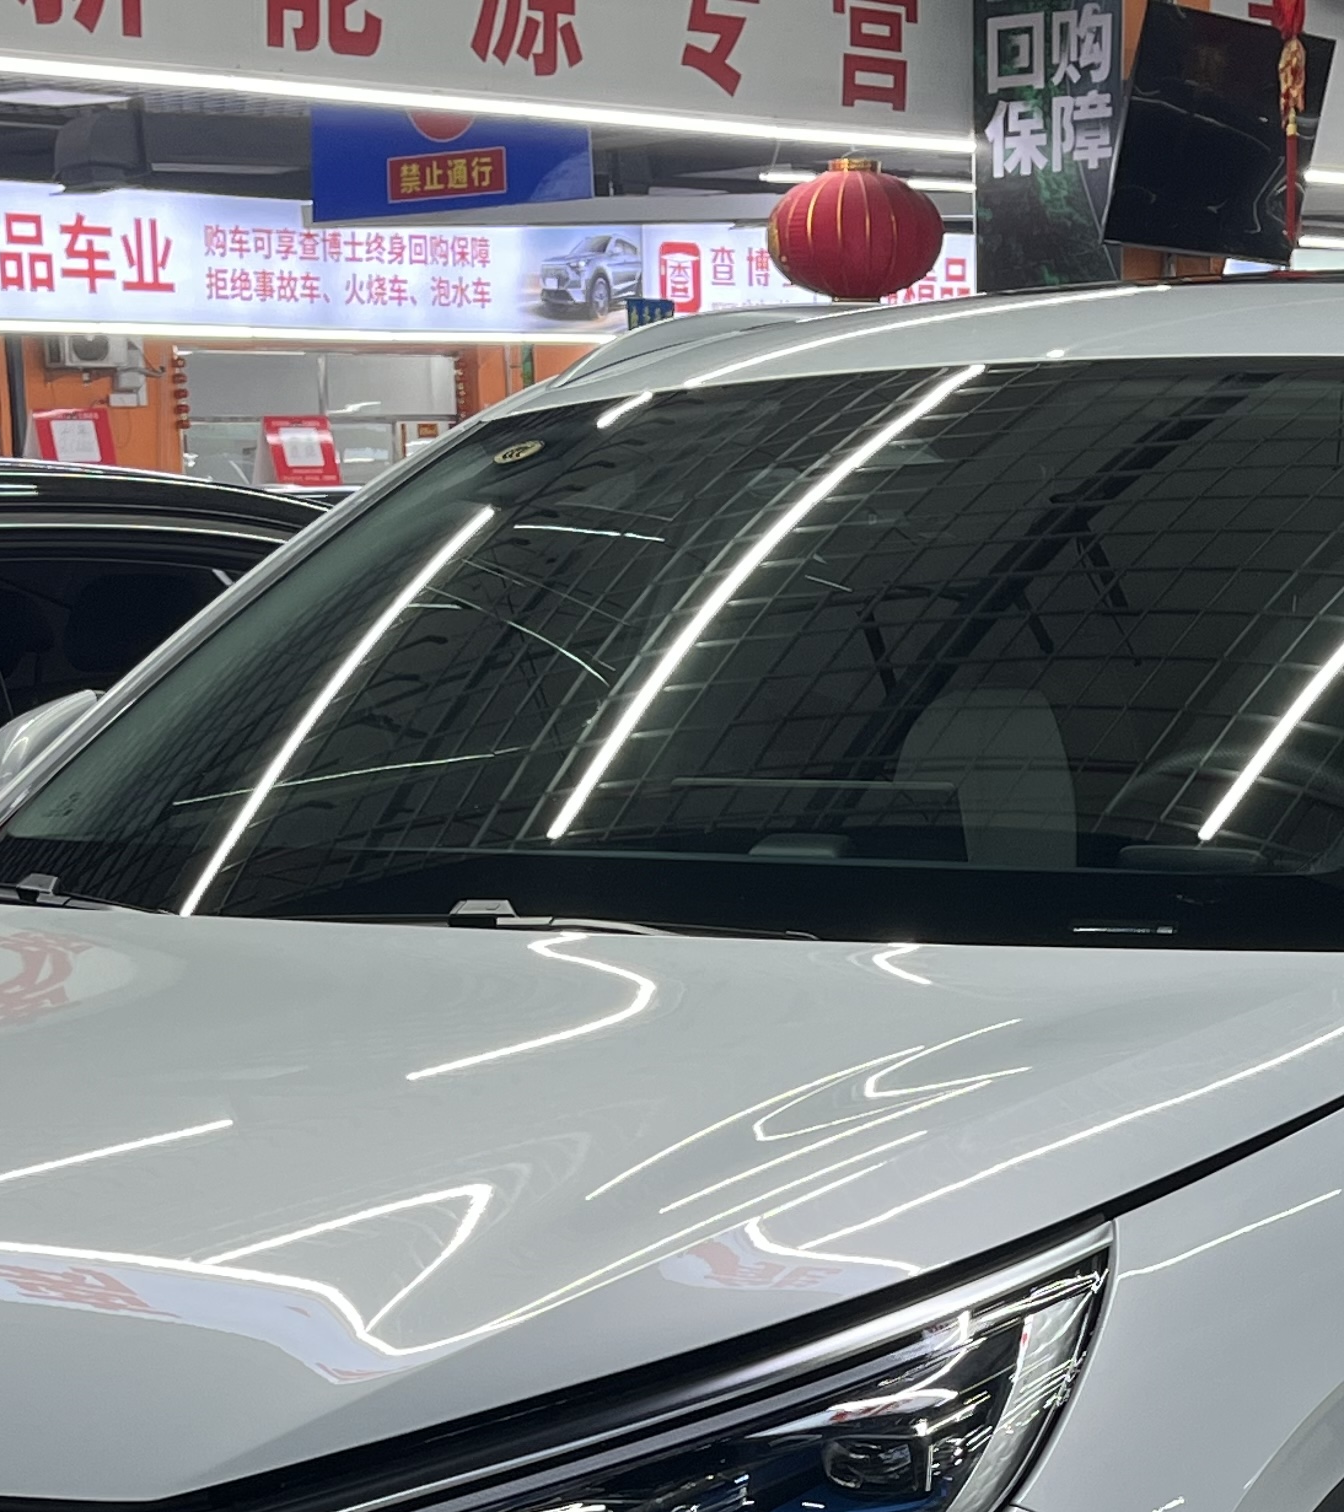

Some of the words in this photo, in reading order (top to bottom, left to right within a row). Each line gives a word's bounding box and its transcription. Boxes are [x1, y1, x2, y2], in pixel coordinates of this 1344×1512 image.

[987, 1, 1112, 94] 回购
[985, 89, 1112, 178] 保障
[400, 157, 492, 193] 禁止通行
[204, 224, 490, 268] 购车可享查博士终身回购保障
[710, 246, 794, 287] 查博
